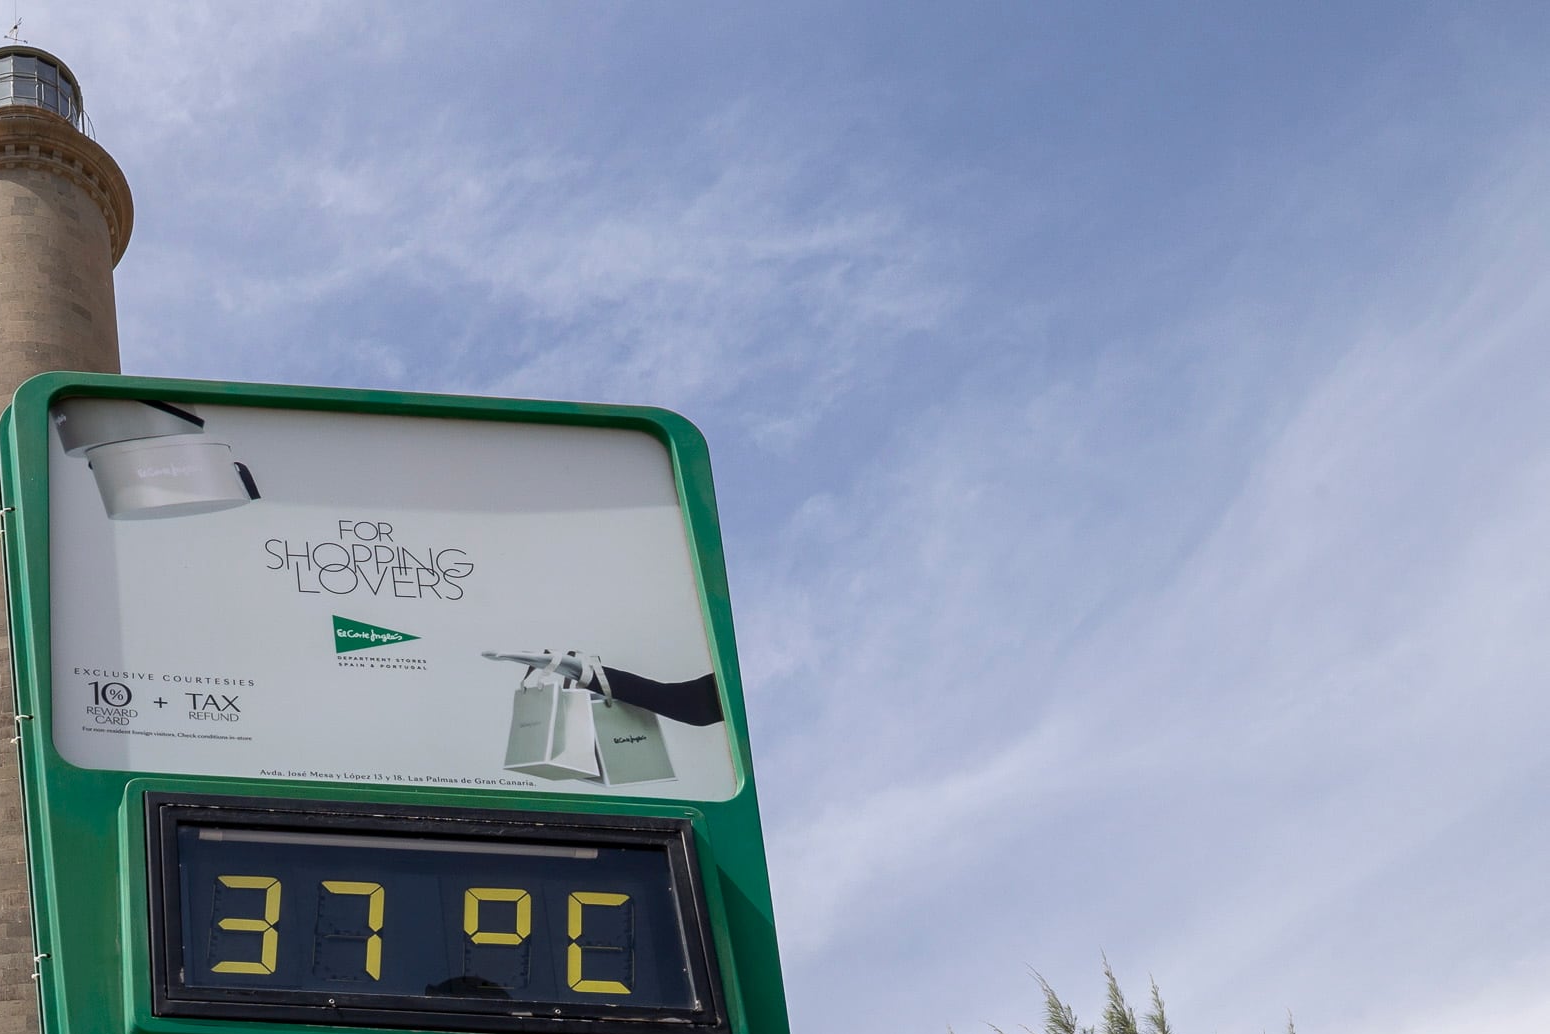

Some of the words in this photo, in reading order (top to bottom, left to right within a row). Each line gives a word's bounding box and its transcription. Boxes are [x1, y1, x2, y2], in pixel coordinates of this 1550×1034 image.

[338, 519, 394, 542] FOR
[264, 538, 475, 578] SHOPPING
[295, 561, 464, 600] LOVERS
[73, 667, 155, 681] EXCLUSIVE
[162, 674, 256, 687] COURTESIES
[86, 706, 139, 719] REWARD
[184, 691, 241, 713] TAX
[94, 715, 131, 726] CARD
[188, 711, 240, 722] REFUND
[259, 768, 285, 777] Avda.
[288, 769, 307, 778] José
[309, 771, 334, 779] Mesa
[343, 772, 371, 781] López
[426, 775, 458, 784] Palmas
[474, 777, 497, 785] Gran
[498, 778, 537, 787] Canaria.
[210, 875, 386, 982] 37
